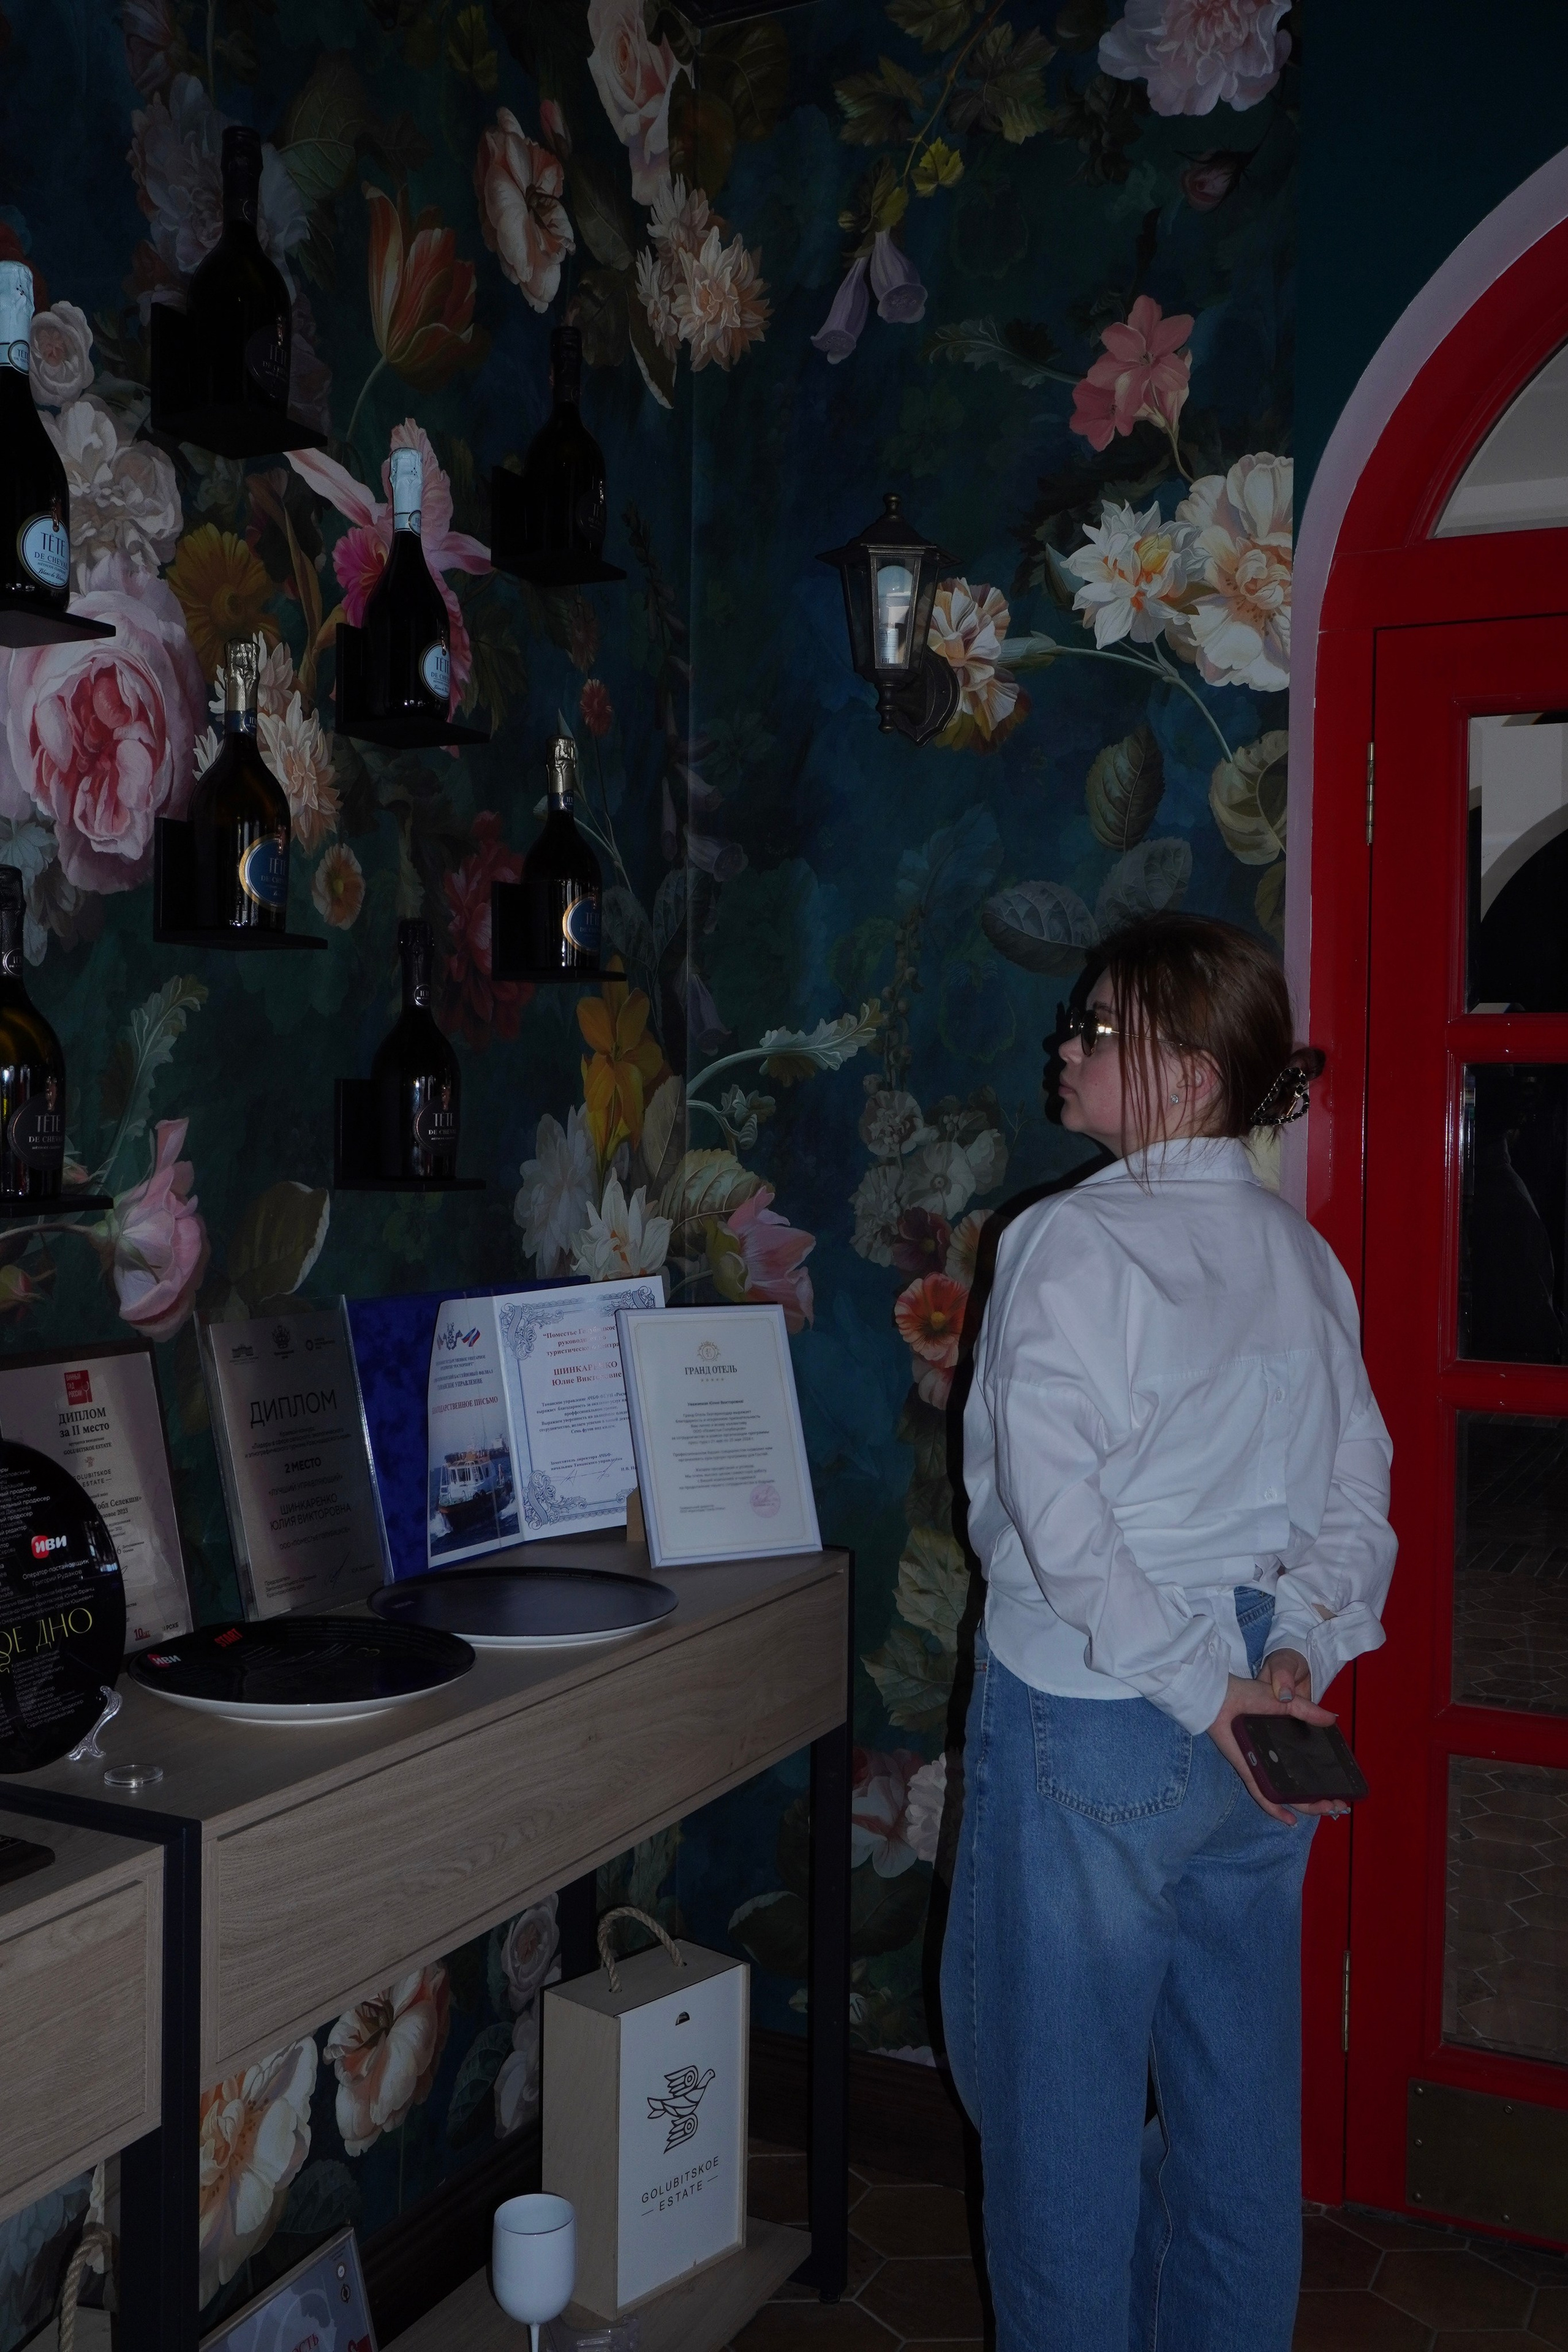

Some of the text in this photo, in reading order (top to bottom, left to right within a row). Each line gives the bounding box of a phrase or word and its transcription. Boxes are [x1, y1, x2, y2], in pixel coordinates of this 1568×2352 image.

[40, 532, 66, 559] TÊTE
[34, 551, 45, 560] DE
[35, 1112, 61, 1134] TÊTE
[29, 1135, 40, 1144] DE
[554, 1361, 617, 1376] ШИНКАРНКО
[685, 1364, 737, 1376] ГРАНД ОТЕЛЬ
[552, 1377, 575, 1386] Юлие
[250, 1389, 337, 1429] ДИПЛОМ
[474, 1396, 499, 1407] ПИСЬМО
[58, 1406, 107, 1427] ДИПЛОМ
[59, 1429, 71, 1438] за
[83, 1422, 110, 1434] место
[96, 1442, 112, 1450] ESTATE
[284, 1457, 322, 1474] 2 МЕСТО
[9, 1485, 37, 1496] продюсер
[82, 1477, 105, 1488] ESTATE
[22, 1495, 51, 1506] продюсер
[280, 1492, 338, 1516] ШИНКАРЕНКО
[7, 1511, 34, 1522] продюсер
[116, 1507, 129, 1516] 2023
[270, 1502, 352, 1532] ЮЛИЯ ВИКТОРОВНА
[22, 1558, 90, 1581] Оператор-постановщик
[32, 1568, 83, 1588] Григорий Рудаков
[36, 1607, 93, 1654] ДНО
[213, 1627, 244, 1648] START
[641, 2155, 719, 2204] GOLUBITSKOE
[659, 2179, 703, 2212] ESTATE
